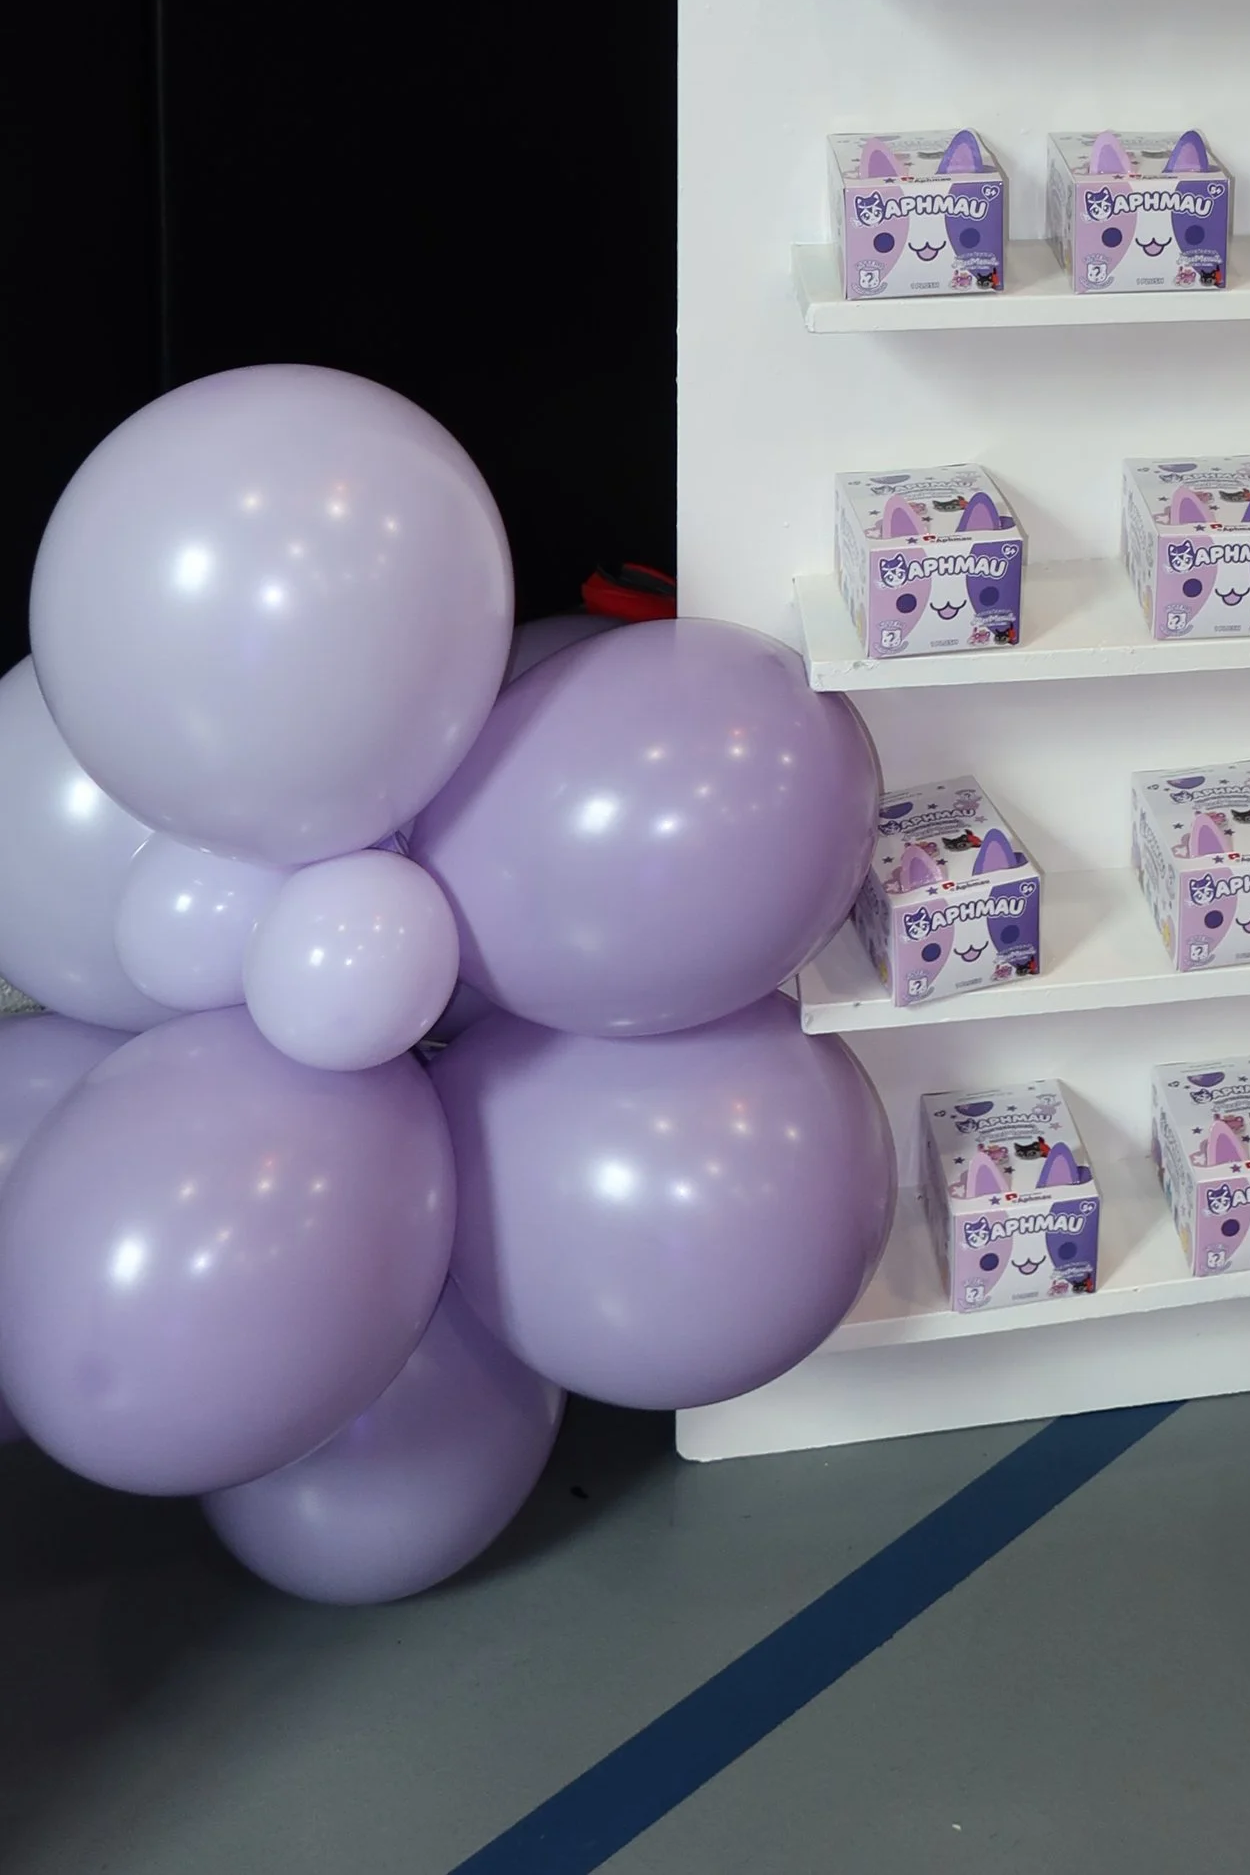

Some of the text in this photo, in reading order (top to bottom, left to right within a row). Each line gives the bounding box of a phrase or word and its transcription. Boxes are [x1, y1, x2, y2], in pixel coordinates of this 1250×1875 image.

[884, 196, 987, 221] APHMAU
[1113, 192, 1212, 217] APHMAU
[907, 554, 1007, 579] APHMAU
[931, 897, 1024, 930] APHMAU
[991, 1214, 1084, 1241] APHMAU
